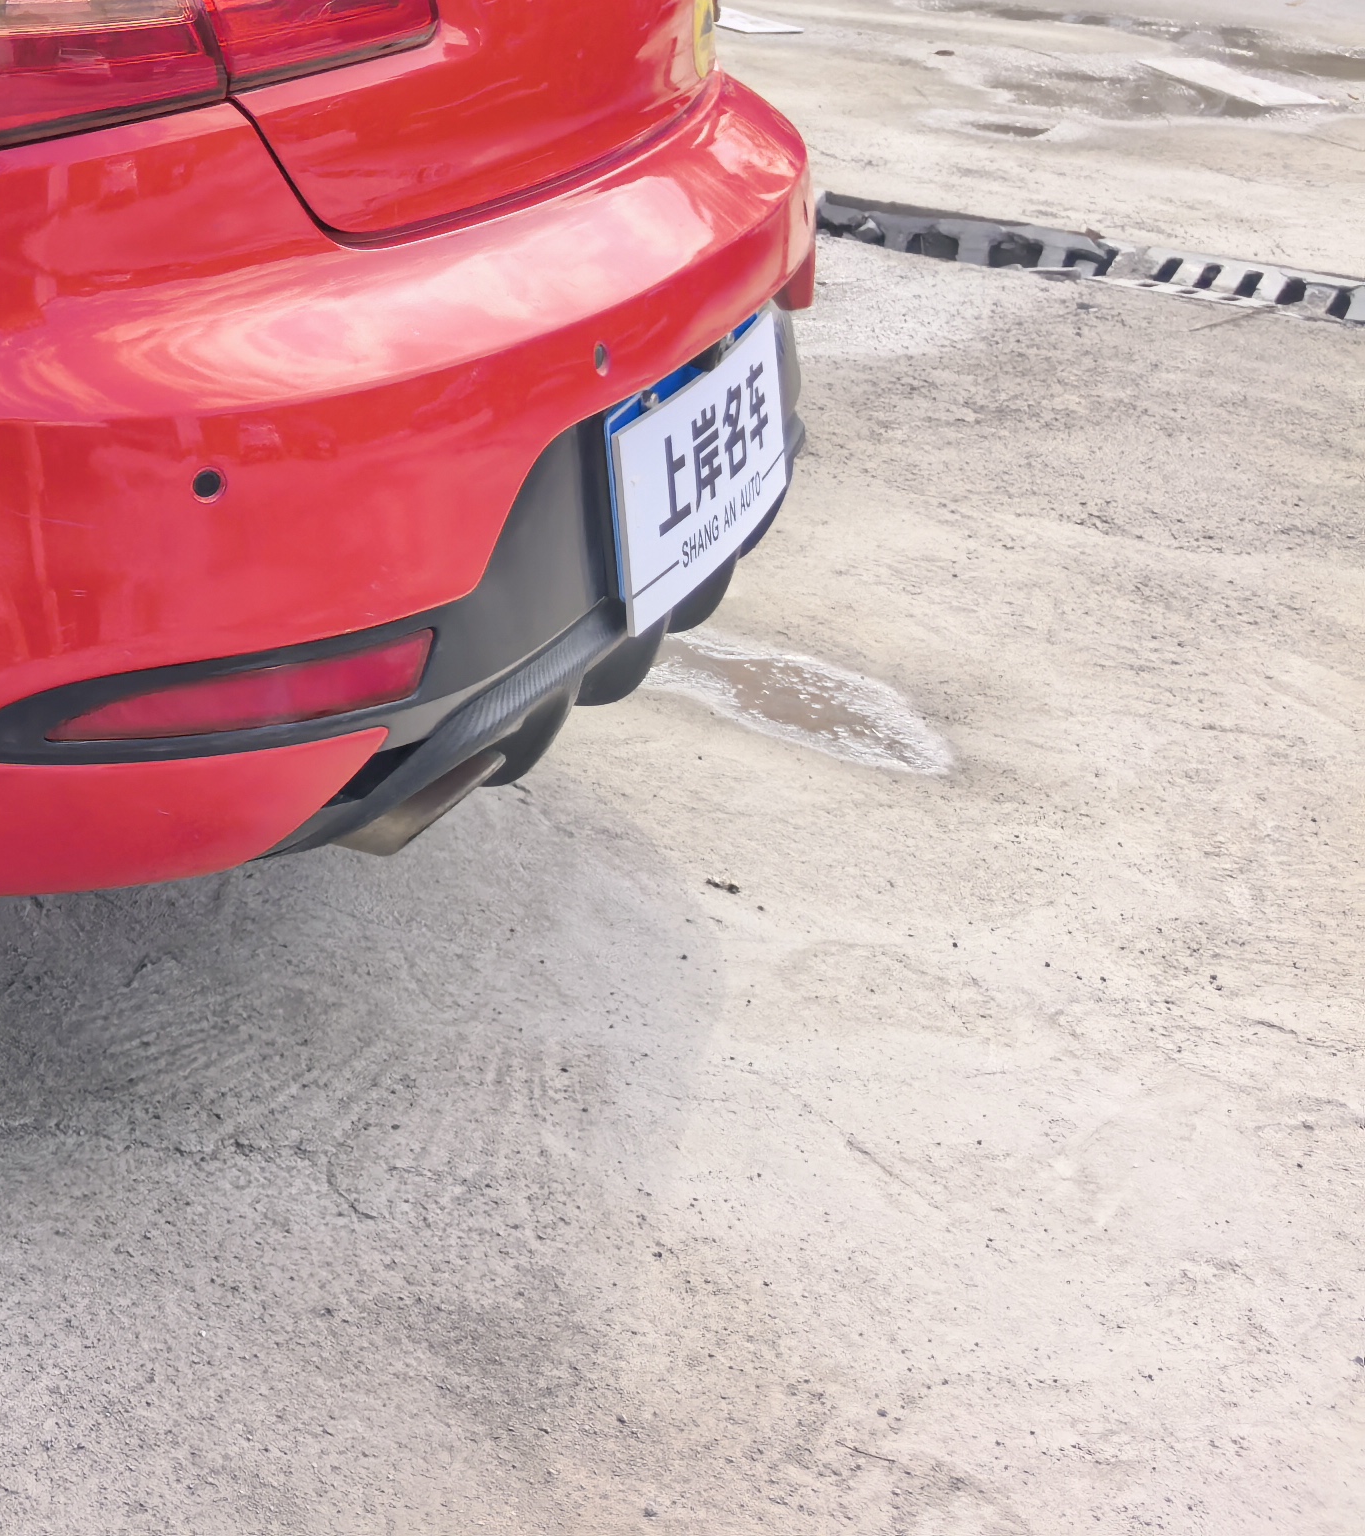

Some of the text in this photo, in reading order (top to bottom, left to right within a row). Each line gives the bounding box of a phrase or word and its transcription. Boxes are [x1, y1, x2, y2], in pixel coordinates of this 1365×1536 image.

[658, 361, 769, 538] 上岸名车
[681, 470, 761, 568] SHANG AN AUTO
